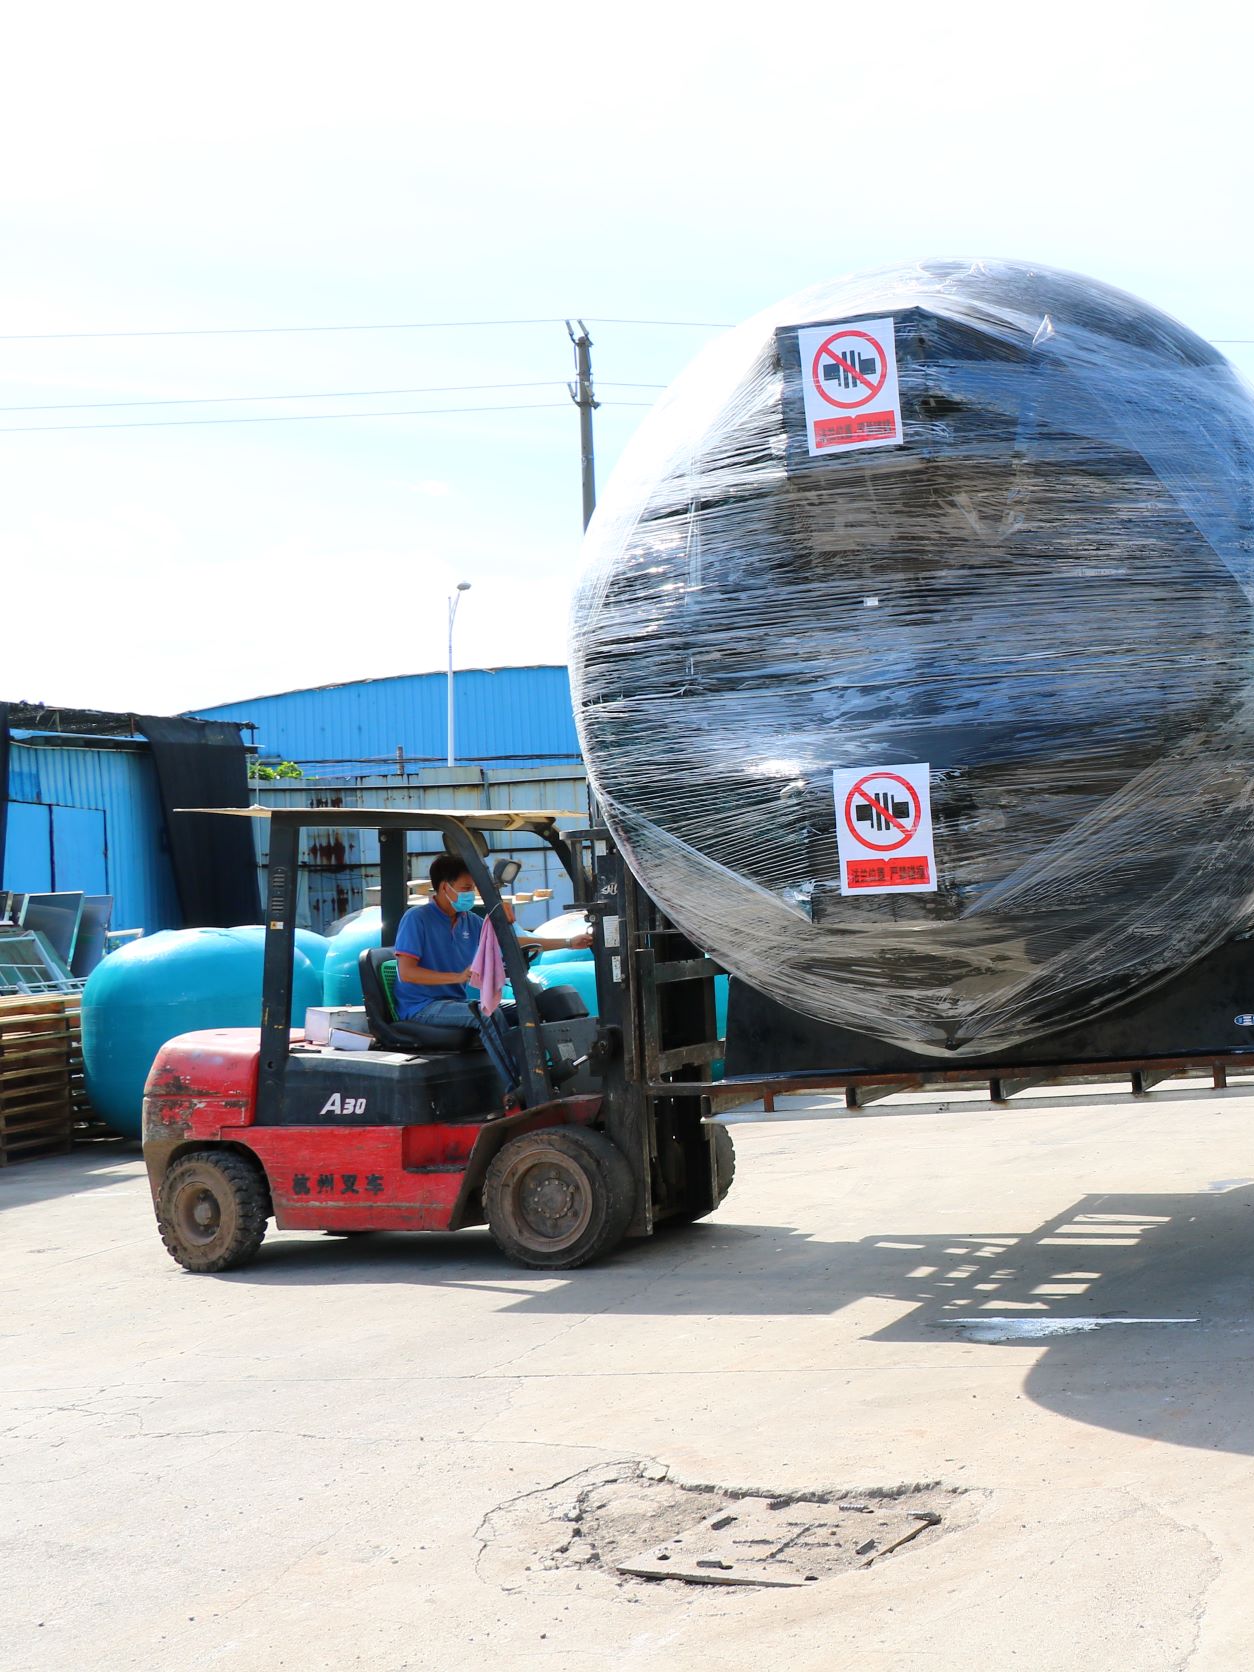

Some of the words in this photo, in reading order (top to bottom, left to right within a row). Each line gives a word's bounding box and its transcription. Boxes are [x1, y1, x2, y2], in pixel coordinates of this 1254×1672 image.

[319, 1092, 367, 1115] A30
[291, 1173, 385, 1196] 杭州叉车
